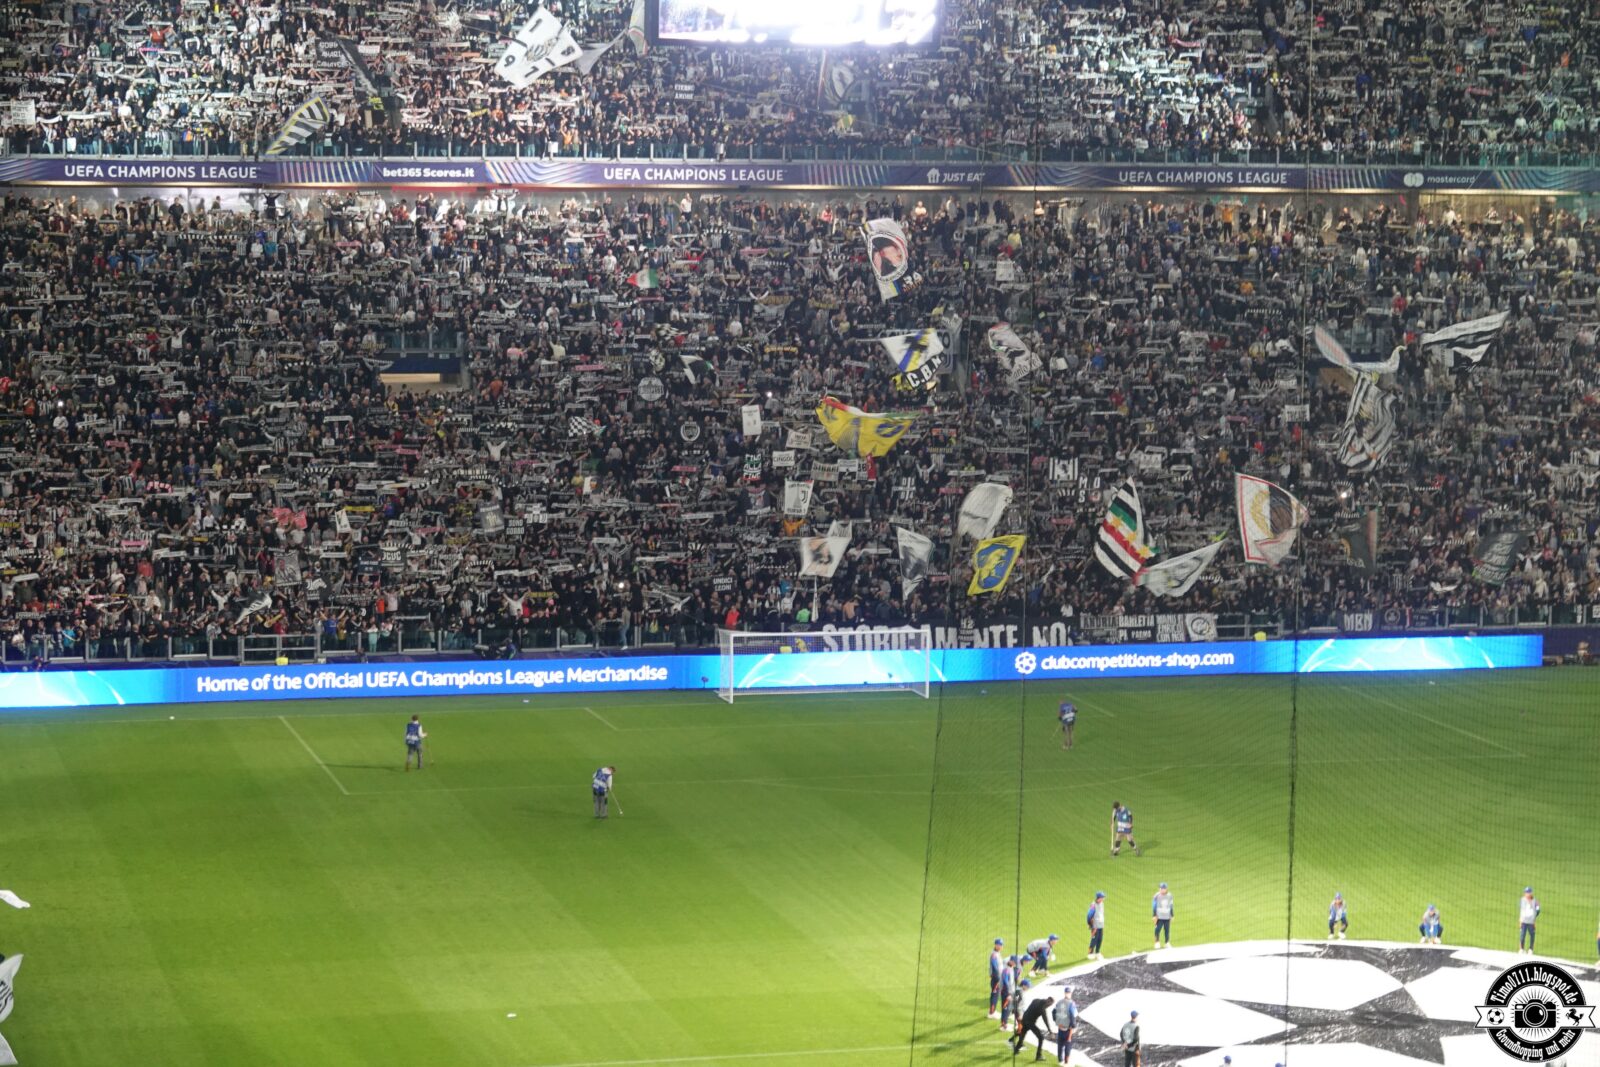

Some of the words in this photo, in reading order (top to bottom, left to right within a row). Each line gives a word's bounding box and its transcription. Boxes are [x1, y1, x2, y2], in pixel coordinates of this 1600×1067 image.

[64, 165, 103, 177] UEFA
[107, 166, 196, 178] CHAMPIONS
[201, 166, 257, 178] LEAGUE
[604, 168, 641, 180] UEFA
[644, 168, 727, 181] CHAMPIONS
[731, 170, 784, 181] LEAGUE
[942, 172, 966, 182] JUST
[966, 172, 986, 182] EAT
[1119, 172, 1153, 182] UEFA
[1156, 172, 1234, 184] CHAMPIONS
[1238, 172, 1288, 184] LEAGUE
[1428, 176, 1475, 184] mastercard
[1041, 652, 1234, 671] clubcompetitions-shop.com
[197, 677, 249, 692] Home
[252, 674, 271, 690] of
[272, 674, 302, 690] the
[304, 672, 363, 689] Official
[366, 672, 408, 688] UEFA
[411, 670, 502, 688] Champions
[506, 669, 564, 688] League
[567, 666, 668, 684] Merchandise
